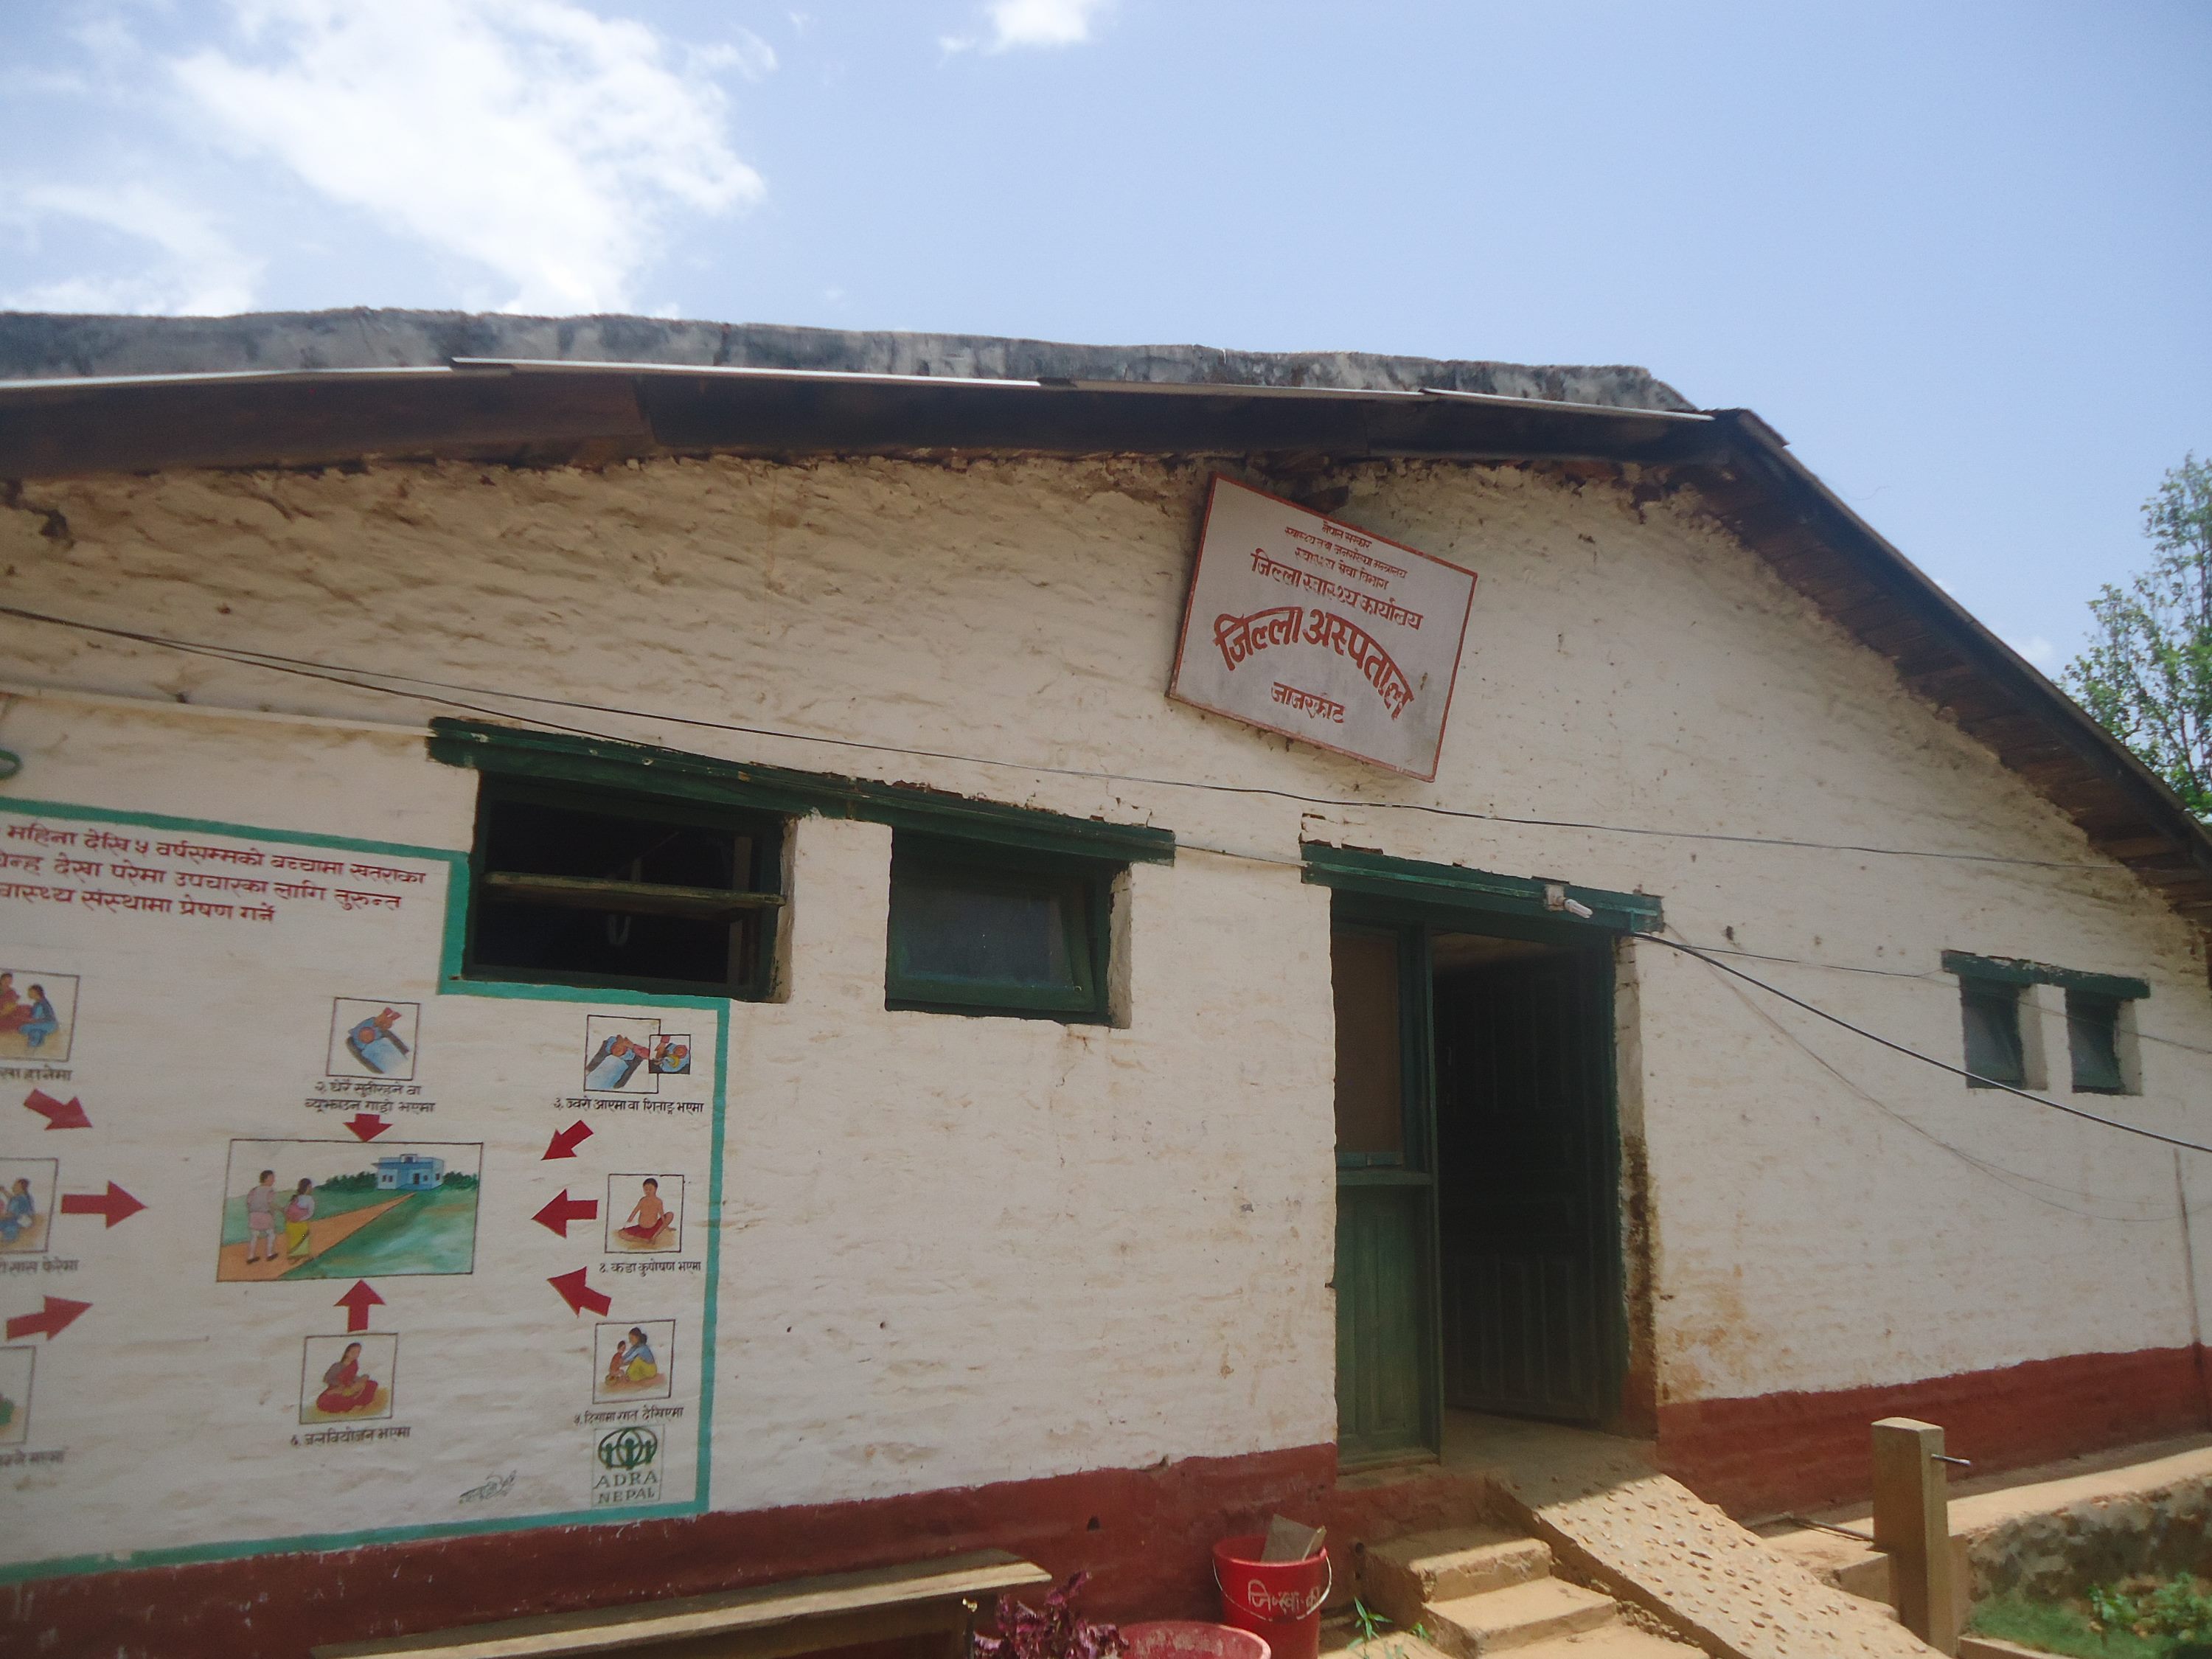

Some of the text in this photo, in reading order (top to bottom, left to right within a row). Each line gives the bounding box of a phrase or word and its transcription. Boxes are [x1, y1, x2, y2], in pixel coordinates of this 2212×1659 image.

[1251, 548, 1302, 588] जिल्ला
[1361, 597, 1424, 630] कार्यालय
[1213, 606, 1415, 720] जिल्ला अस्पताल
[7, 823, 78, 847] महिना
[84, 829, 131, 855] देखि
[55, 852, 103, 883] देखा
[111, 859, 167, 885] परेमा
[174, 872, 268, 897] उपचारका
[274, 880, 327, 900] लागि
[81, 889, 173, 913] संस्थामा
[178, 894, 234, 919] प्रेषण
[594, 1470, 658, 1489] ADRA
[598, 1487, 655, 1503] NEPAL
